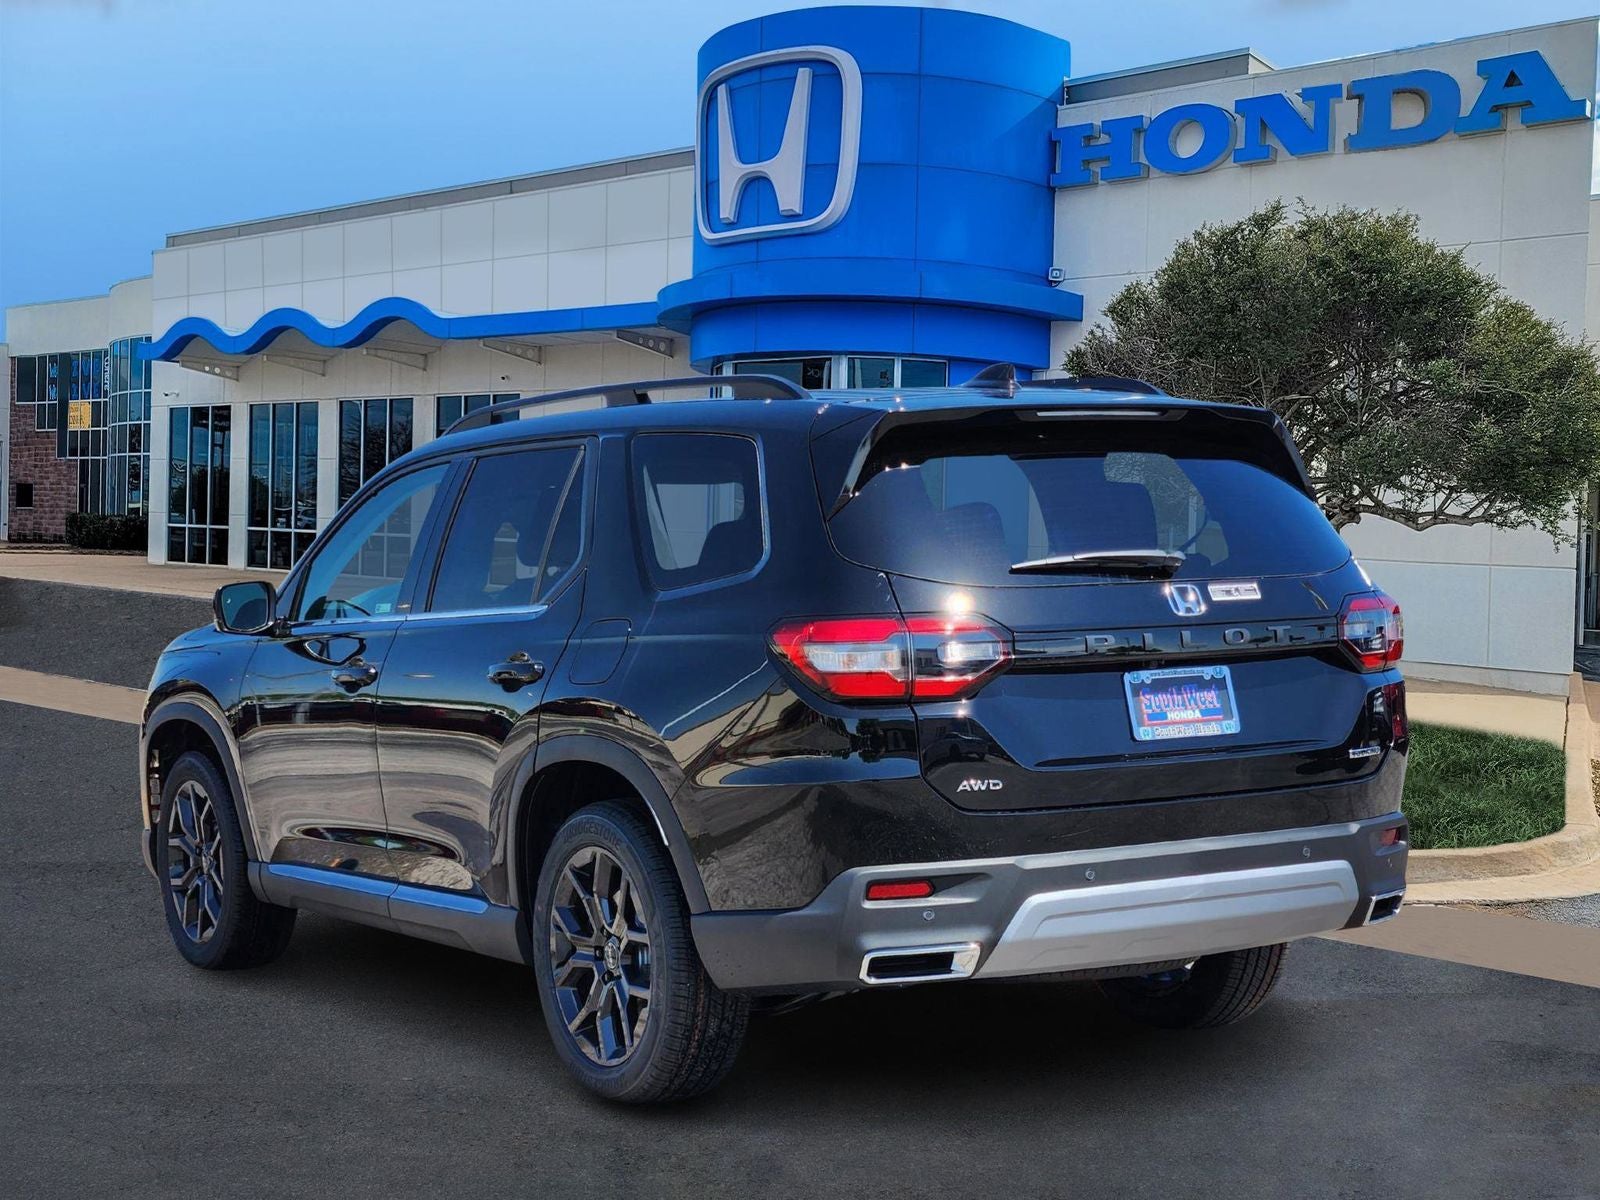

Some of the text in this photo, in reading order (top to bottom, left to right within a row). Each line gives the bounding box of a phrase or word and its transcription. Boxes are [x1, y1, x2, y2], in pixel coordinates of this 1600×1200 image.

[1051, 50, 1590, 187] HONDA
[1085, 626, 1292, 654] PILOT
[1167, 709, 1202, 720] HONDA
[956, 779, 1003, 792] AWD
